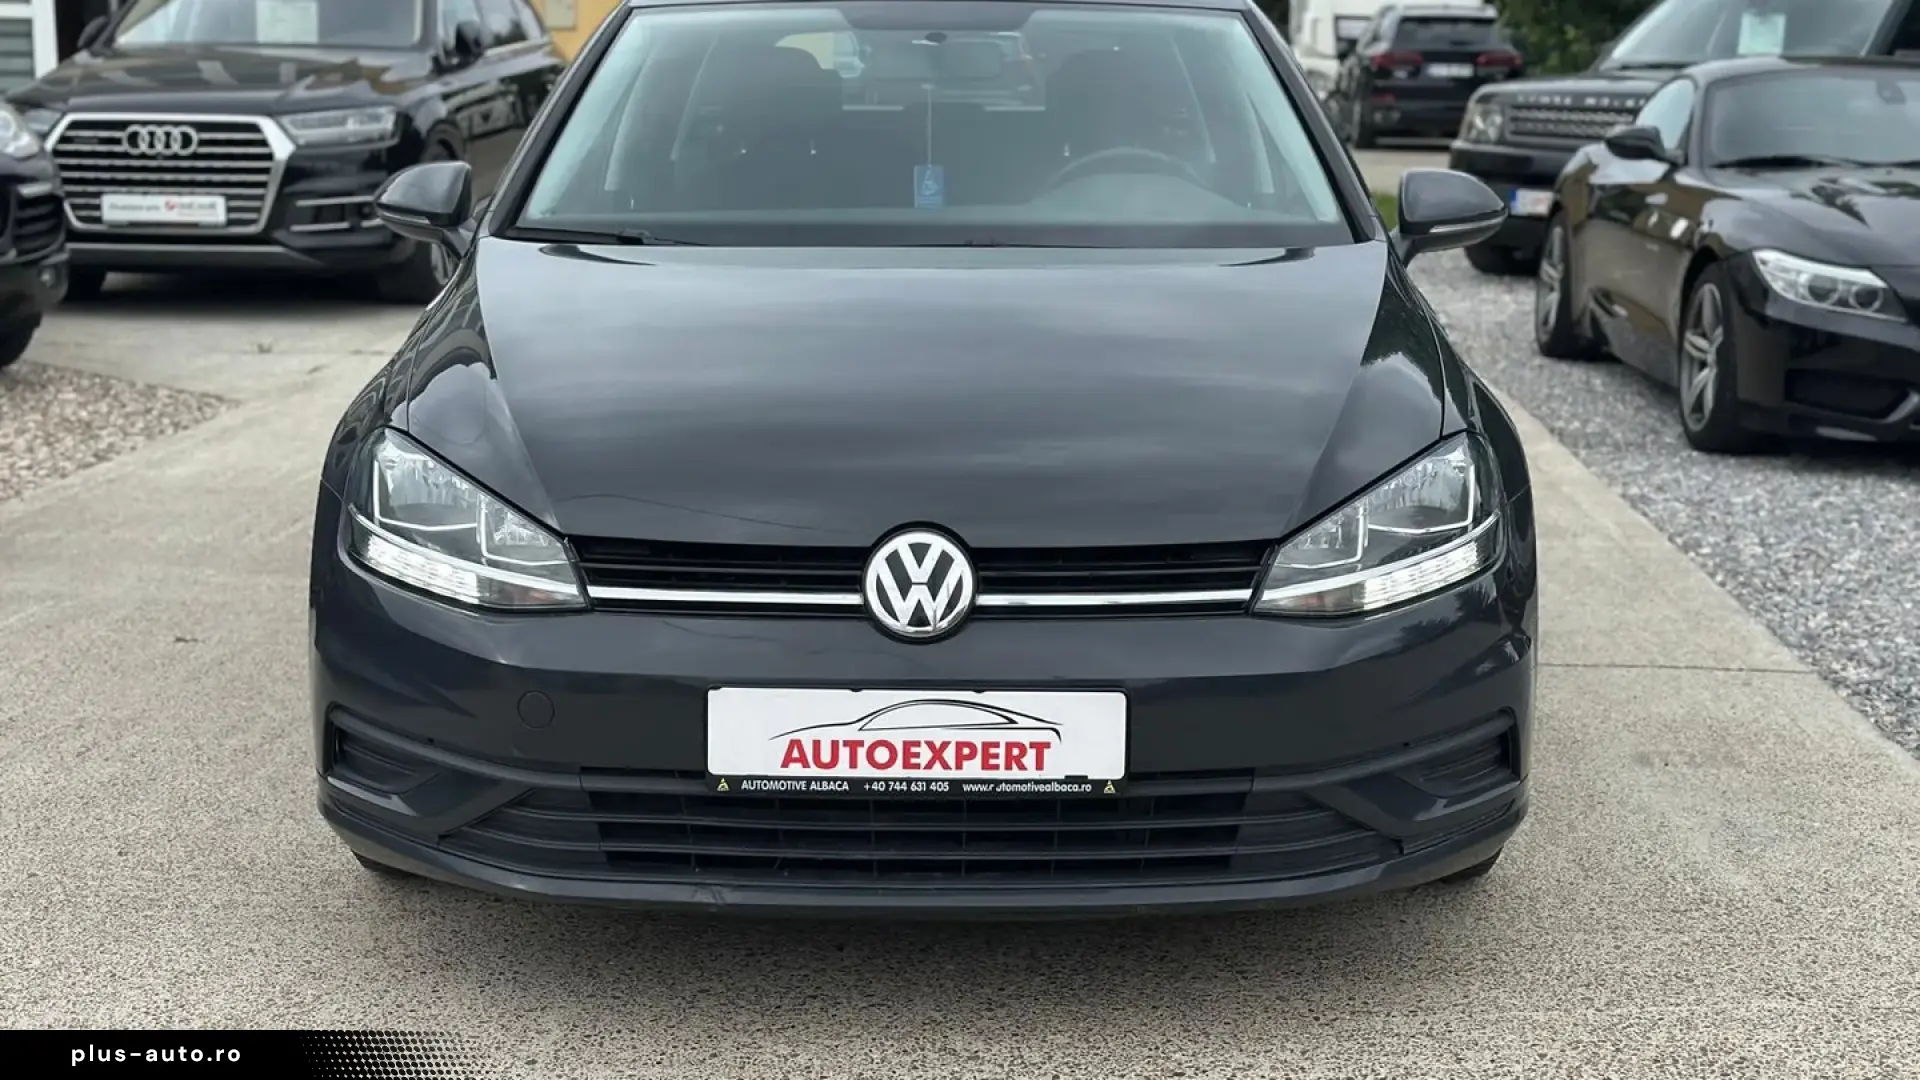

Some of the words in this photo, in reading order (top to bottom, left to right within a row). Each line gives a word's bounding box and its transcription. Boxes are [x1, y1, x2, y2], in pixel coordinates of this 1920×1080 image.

[781, 739, 1052, 772] AUTOEXPERT
[741, 780, 807, 791] AUTOMOTIVE
[810, 781, 850, 792] ALBACA
[863, 781, 886, 793] +40
[888, 781, 908, 793] 744
[909, 781, 926, 793] 631
[930, 781, 949, 793] 405
